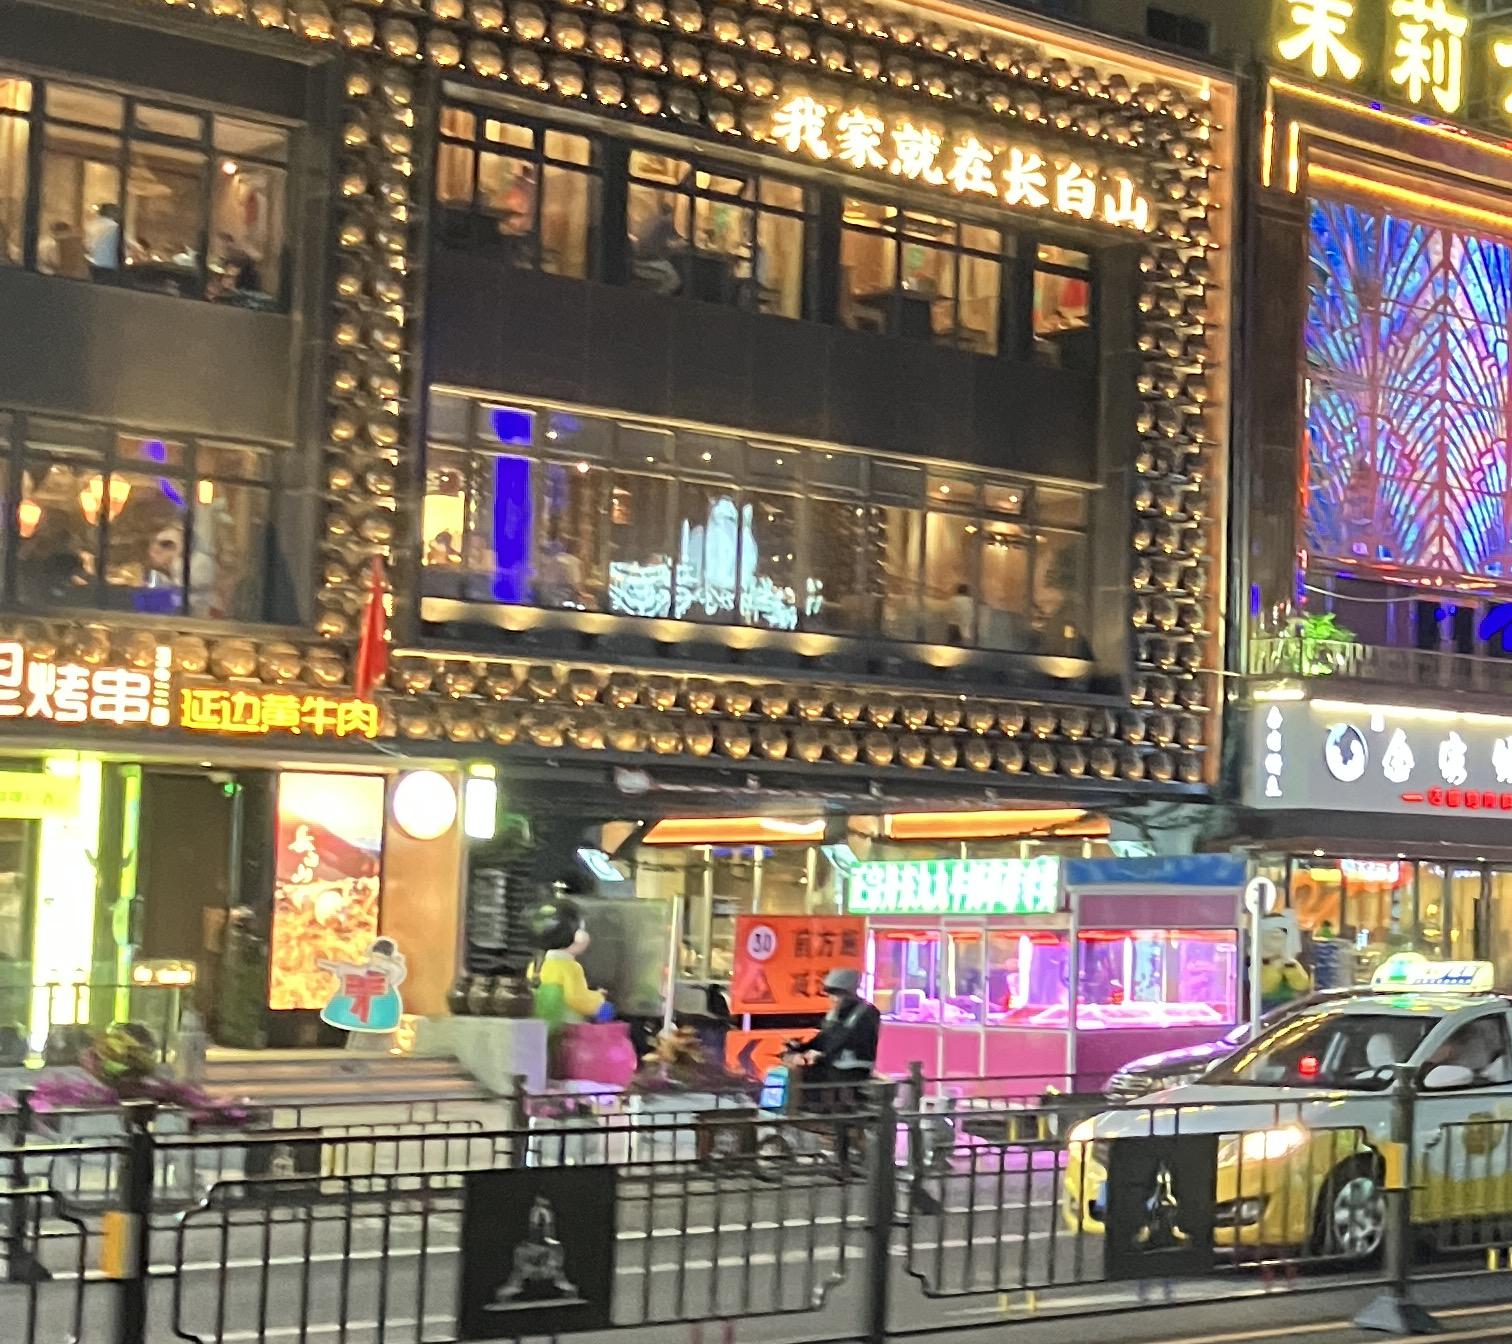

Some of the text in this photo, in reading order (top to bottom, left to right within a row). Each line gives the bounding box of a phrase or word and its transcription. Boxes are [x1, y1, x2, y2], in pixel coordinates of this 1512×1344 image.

[771, 94, 1151, 231] 我家就在长白山
[180, 688, 378, 738] 延边黄牛肉
